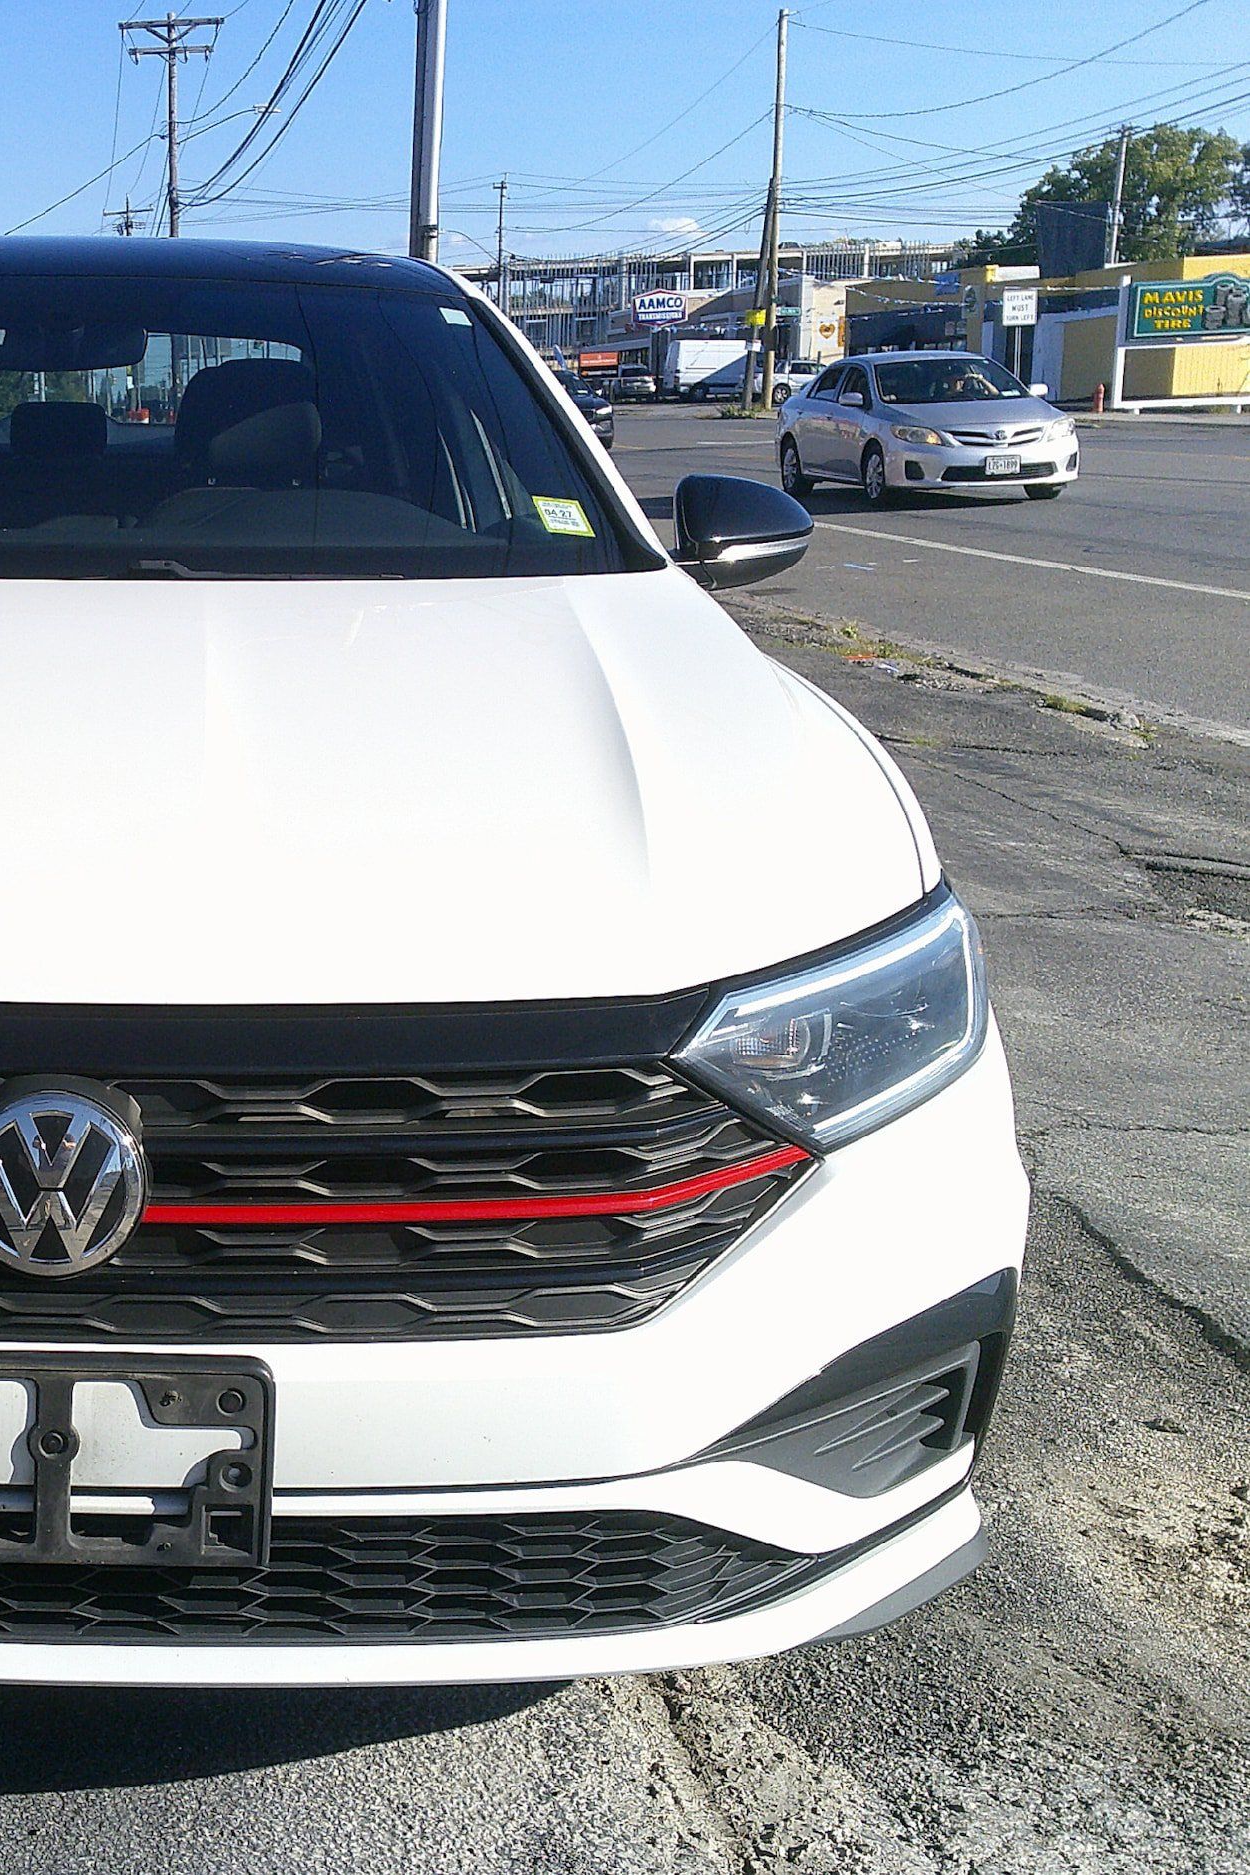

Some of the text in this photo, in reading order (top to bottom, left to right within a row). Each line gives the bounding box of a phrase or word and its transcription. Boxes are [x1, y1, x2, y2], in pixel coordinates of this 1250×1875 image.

[638, 297, 683, 310] AAMCO
[1143, 290, 1204, 304] MAVIS
[1144, 304, 1205, 318] DISCOUNT
[1154, 319, 1191, 329] TIRE
